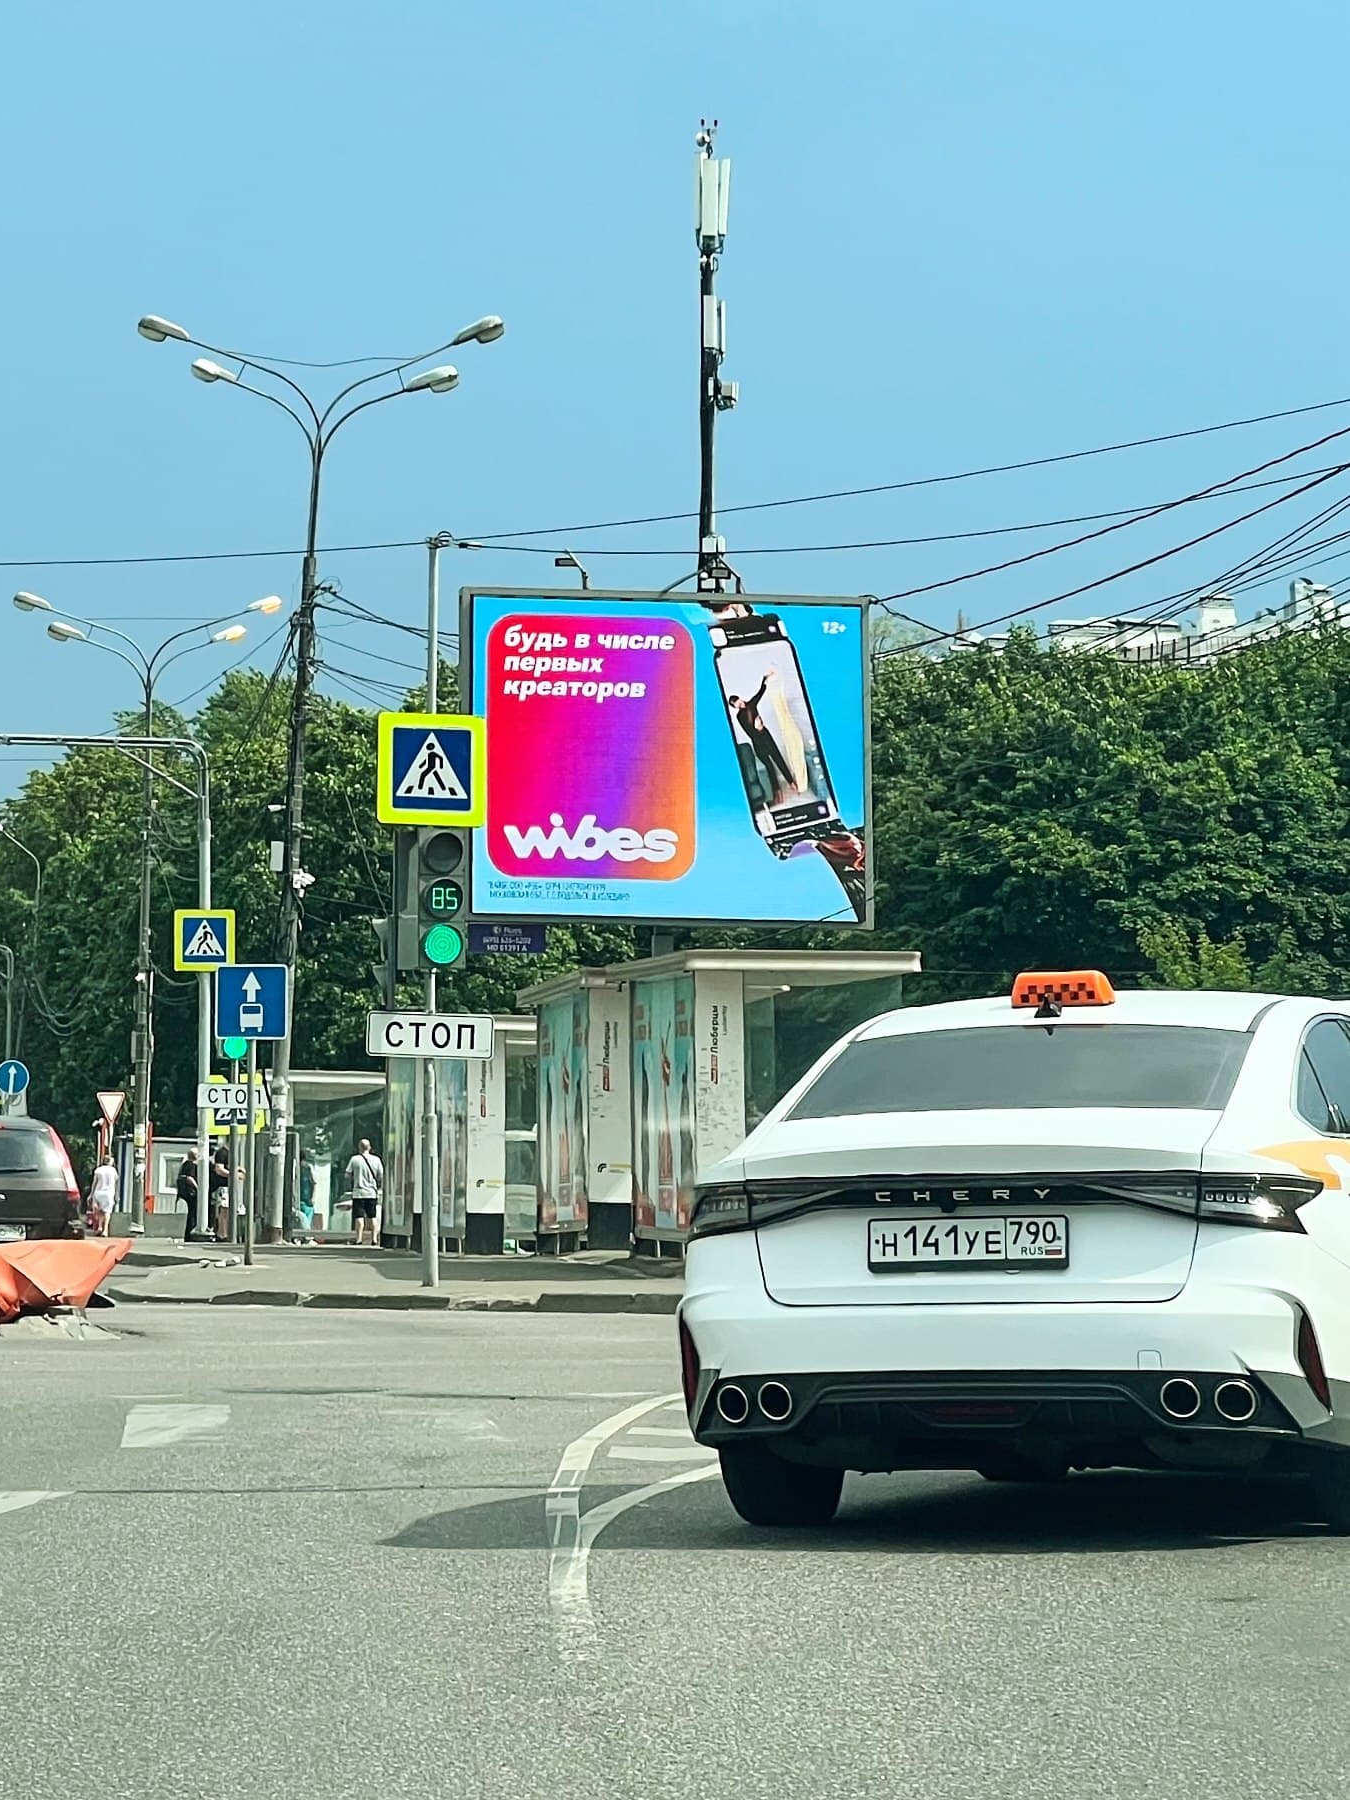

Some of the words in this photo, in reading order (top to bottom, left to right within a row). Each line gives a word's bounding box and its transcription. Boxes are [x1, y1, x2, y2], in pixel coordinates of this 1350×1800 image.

[503, 624, 568, 653] будь
[574, 633, 591, 649] в
[597, 634, 676, 650] числе
[821, 620, 847, 634] 12+
[503, 655, 604, 677] первых
[503, 679, 647, 703] креаторов
[503, 812, 679, 863] wibes
[432, 887, 458, 910] 85
[385, 1021, 475, 1050] СТОП
[710, 1005, 718, 1053] Люберцы
[874, 1188, 1051, 1202] CHERY
[881, 1223, 1002, 1257] Н141УЕ
[1009, 1221, 1058, 1245] 790
[1020, 1246, 1044, 1256] RUS
